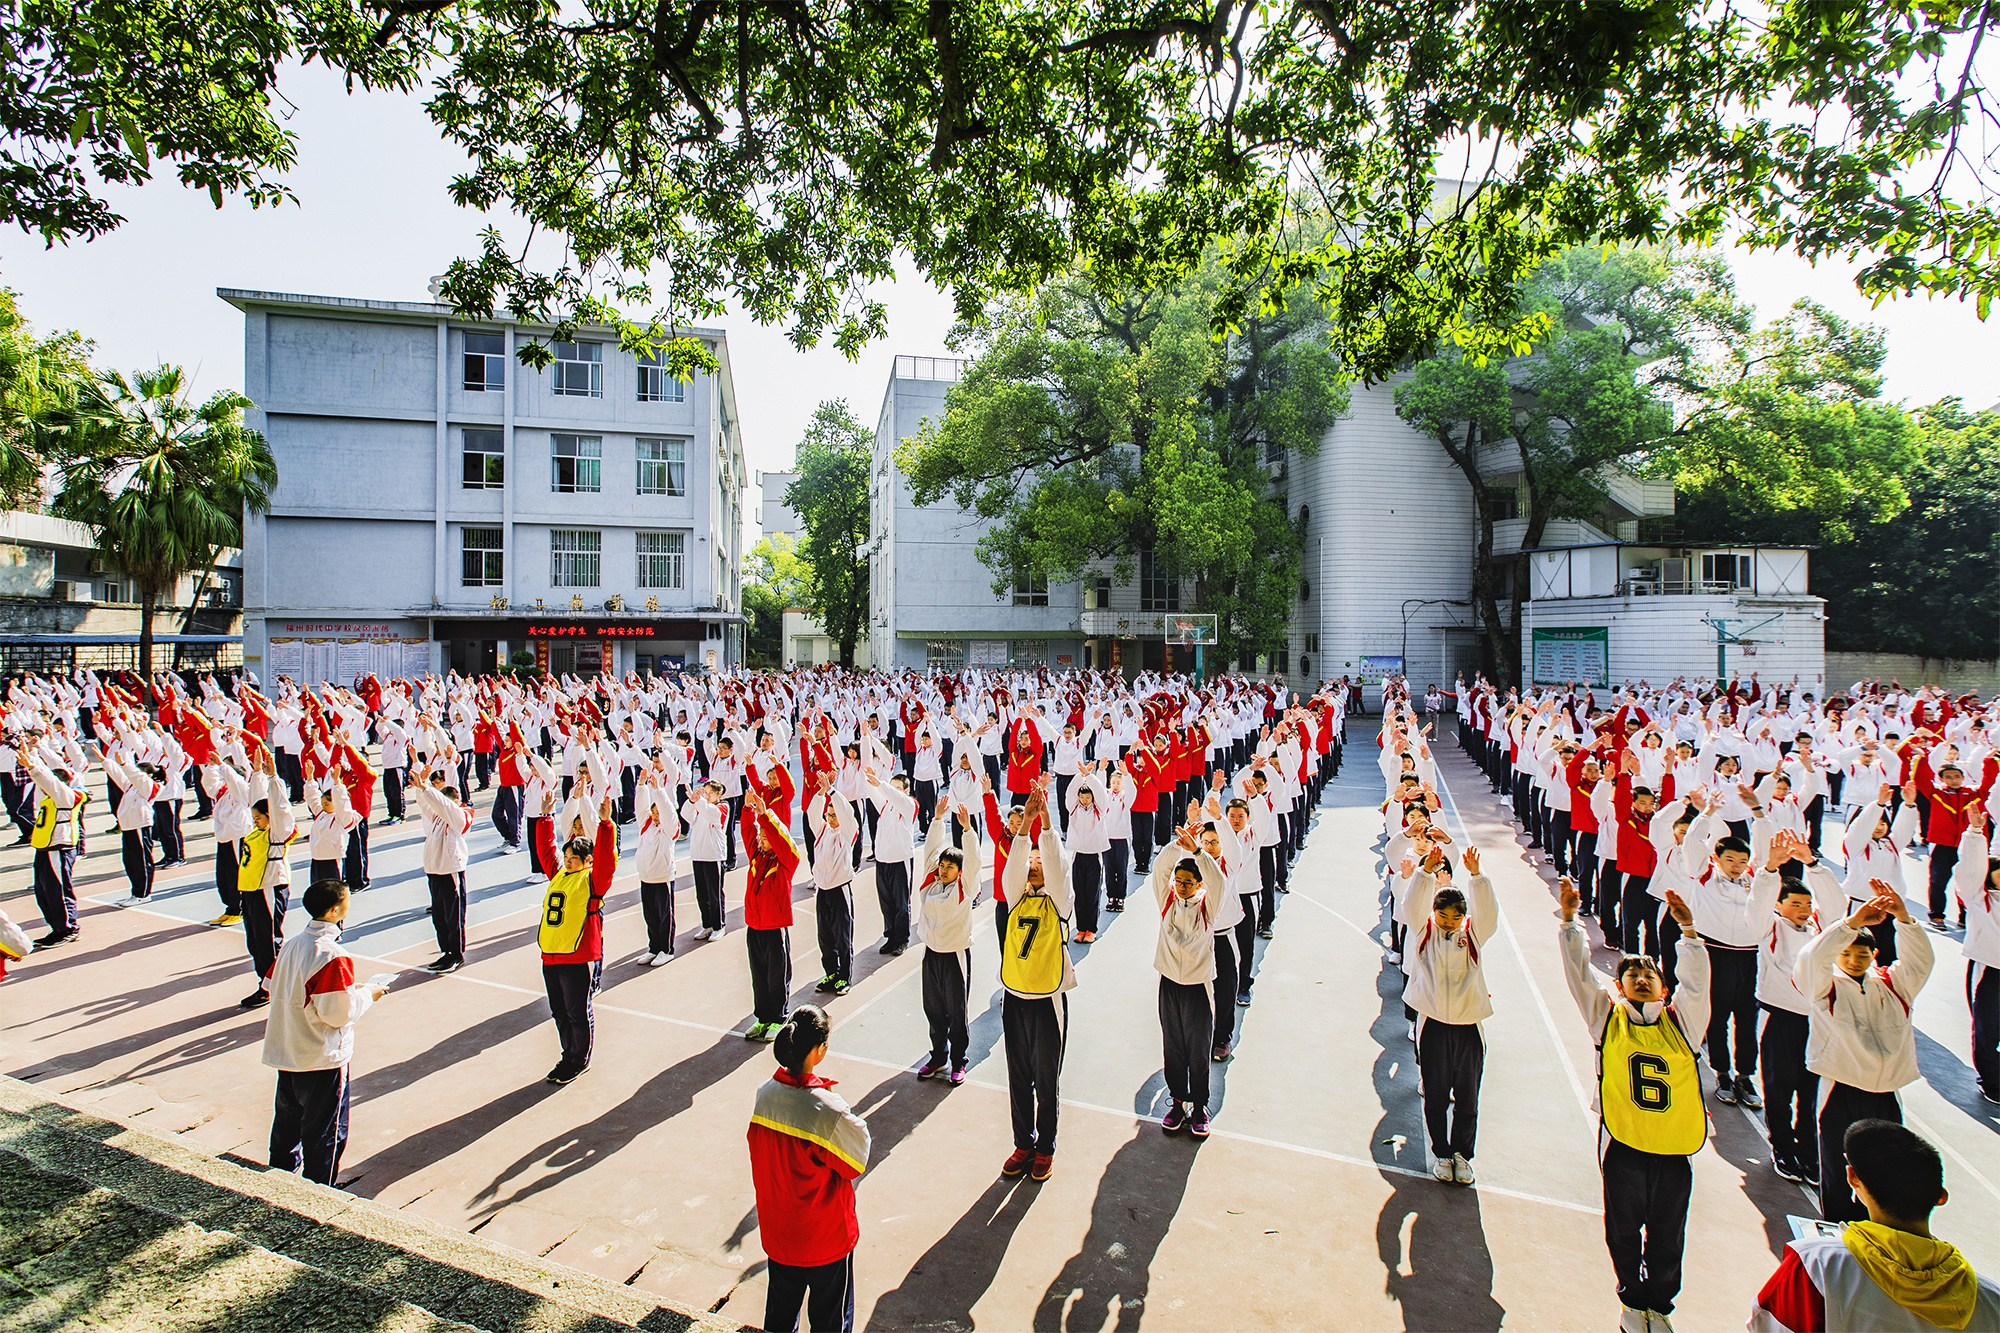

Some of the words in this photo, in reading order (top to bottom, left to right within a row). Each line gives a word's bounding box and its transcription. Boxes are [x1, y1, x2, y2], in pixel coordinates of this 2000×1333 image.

[489, 593, 661, 611] 初二教学楼
[528, 626, 587, 636] 关心爱护学生
[597, 626, 655, 636] 加强安全防范
[546, 890, 567, 928] 8
[1017, 916, 1041, 960] 7
[1628, 1051, 1671, 1113] 6
